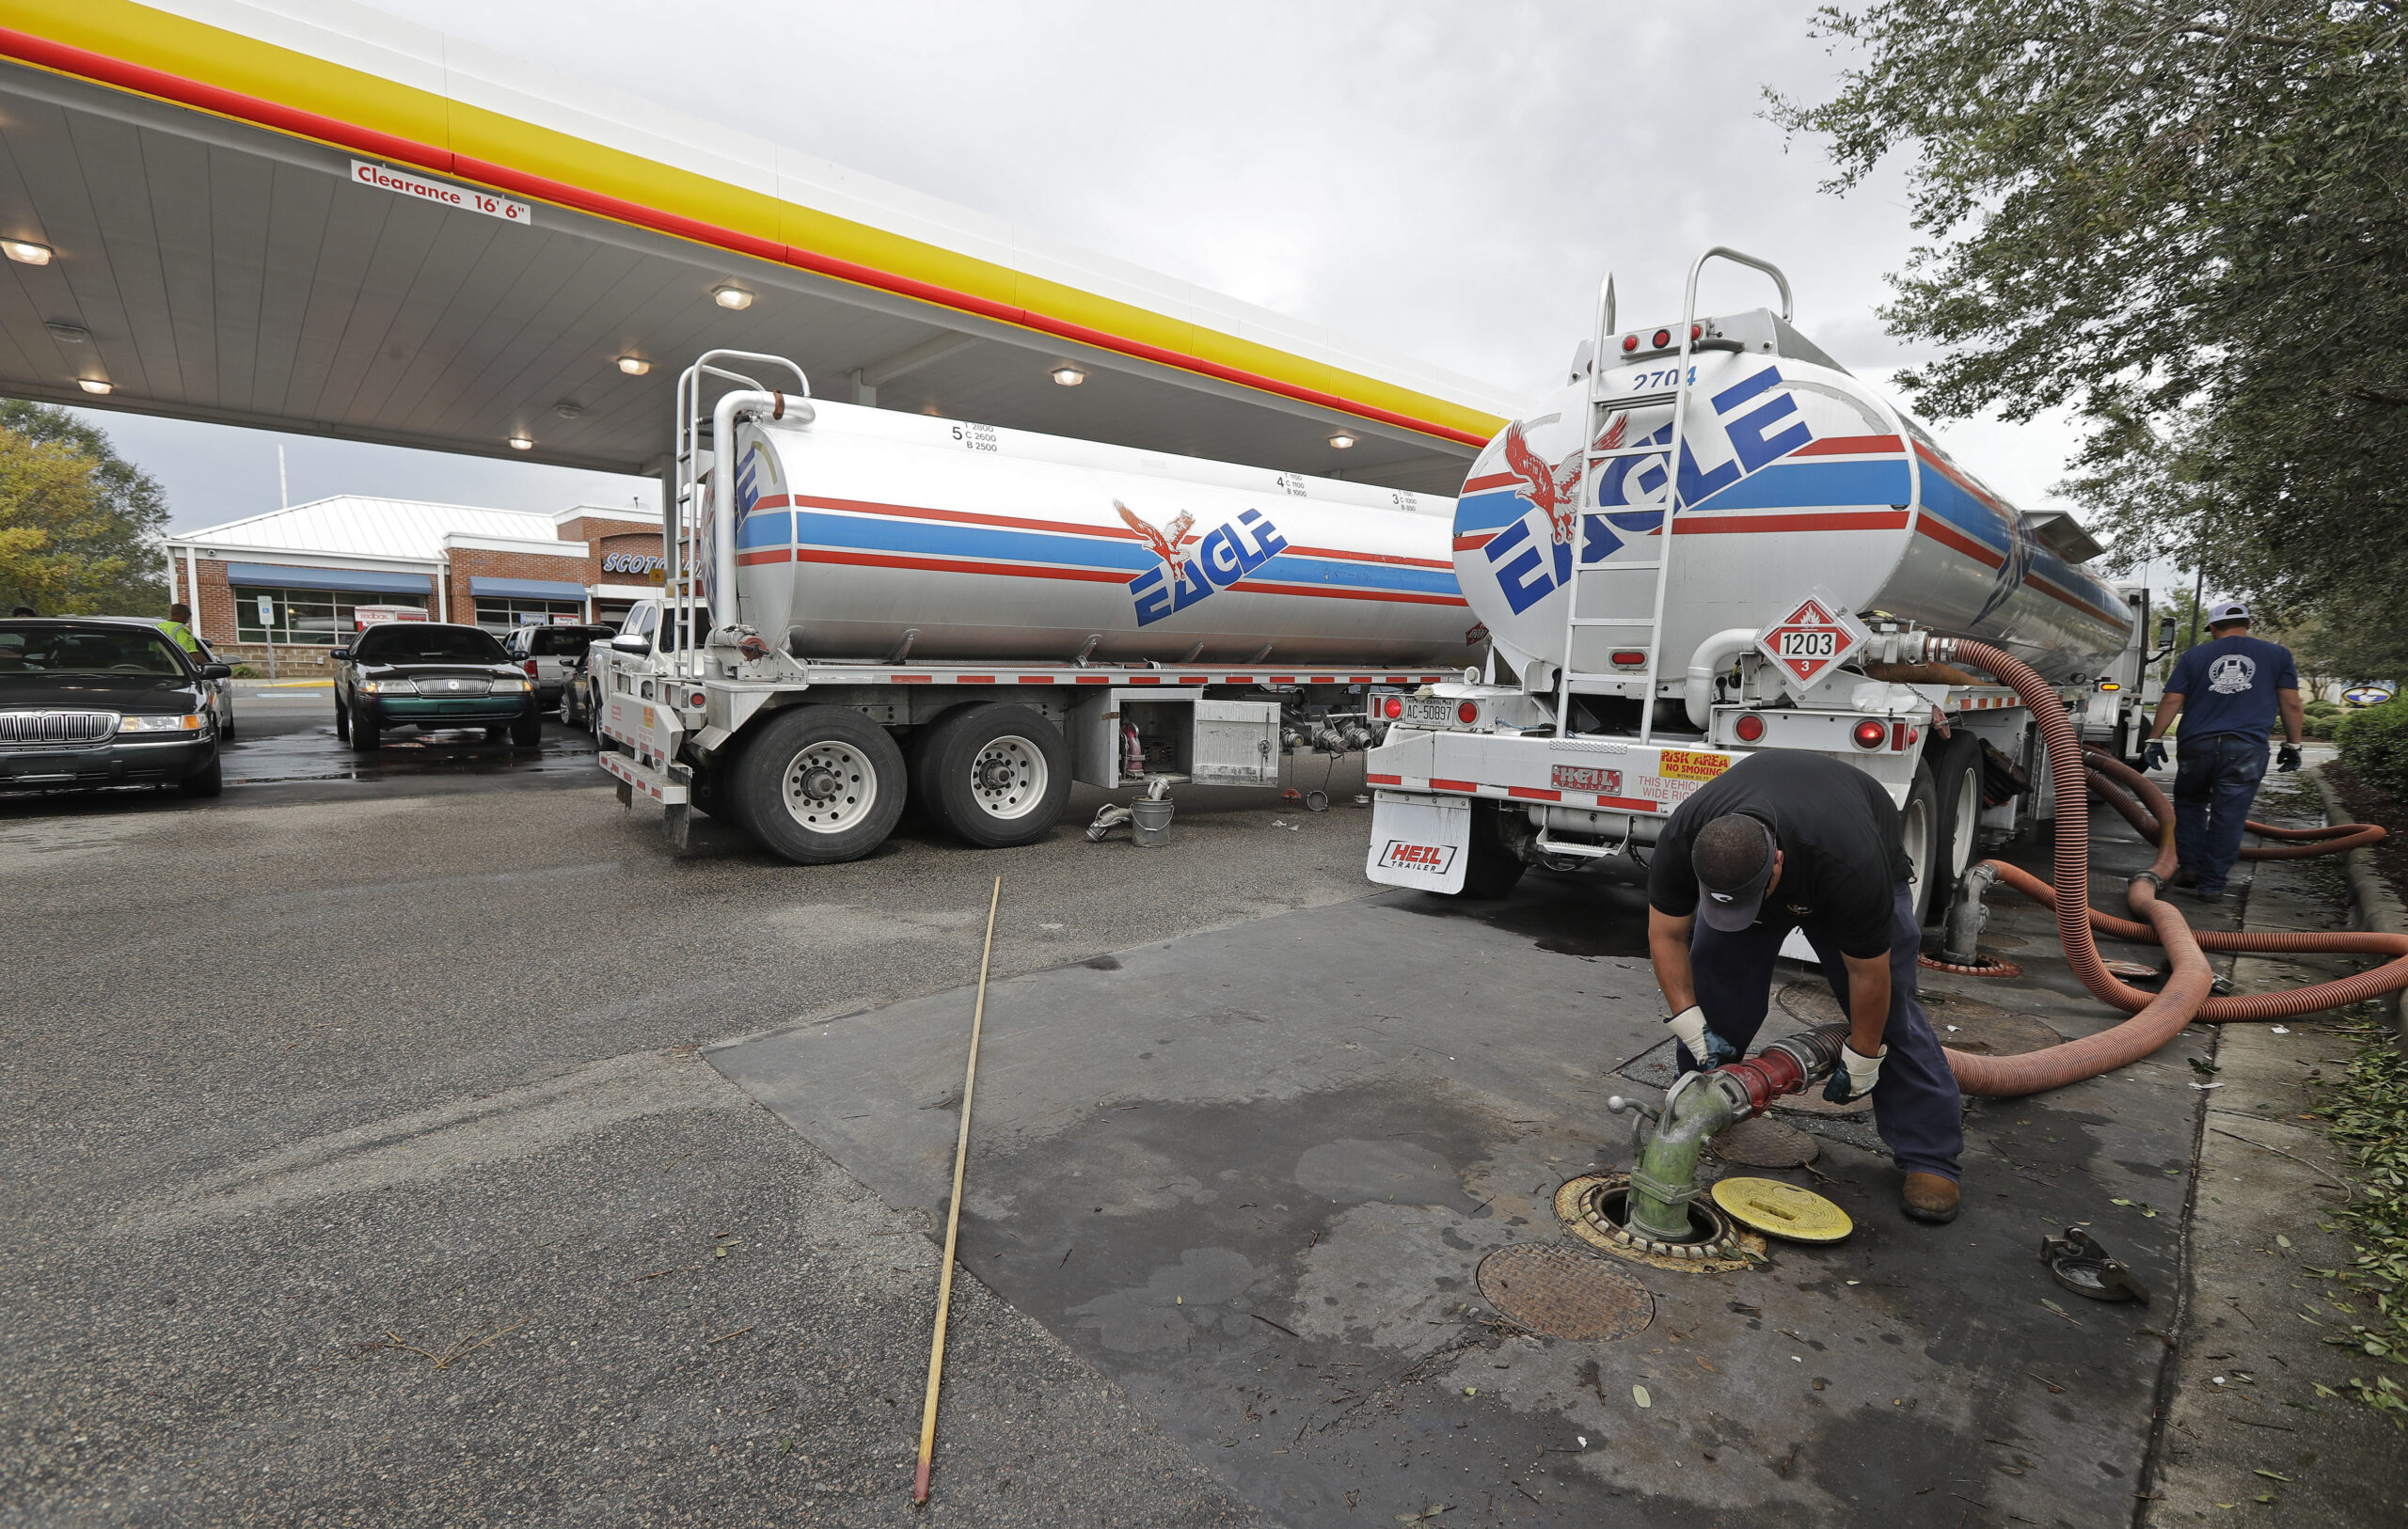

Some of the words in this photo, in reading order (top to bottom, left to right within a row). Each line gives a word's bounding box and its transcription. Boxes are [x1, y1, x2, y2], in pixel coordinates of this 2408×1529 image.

[357, 166, 461, 204] Clearance
[475, 196, 499, 213] 16'
[505, 204, 525, 219] 6"
[1633, 366, 1697, 390] 2704
[952, 426, 963, 440] 5
[966, 441, 974, 449] B
[975, 442, 997, 452] 2500
[1276, 477, 1284, 487] 4
[1484, 365, 1814, 616] EAGLE
[1392, 493, 1400, 505] 3
[1129, 508, 1288, 627] EAGLE
[1783, 633, 1832, 655] 1203
[1800, 660, 1810, 671] 3
[1407, 704, 1451, 720] AC-50897
[1661, 750, 1689, 764] RISK
[1693, 754, 1729, 768] AREA
[1665, 764, 1679, 772] NO
[1681, 764, 1722, 776] SMOKING
[1639, 775, 1661, 788] THIS
[1664, 779, 1700, 792] VEHICL
[1642, 787, 1669, 799] WIDE
[1390, 843, 1441, 865] HEIL
[1392, 860, 1436, 872] TRAILER
